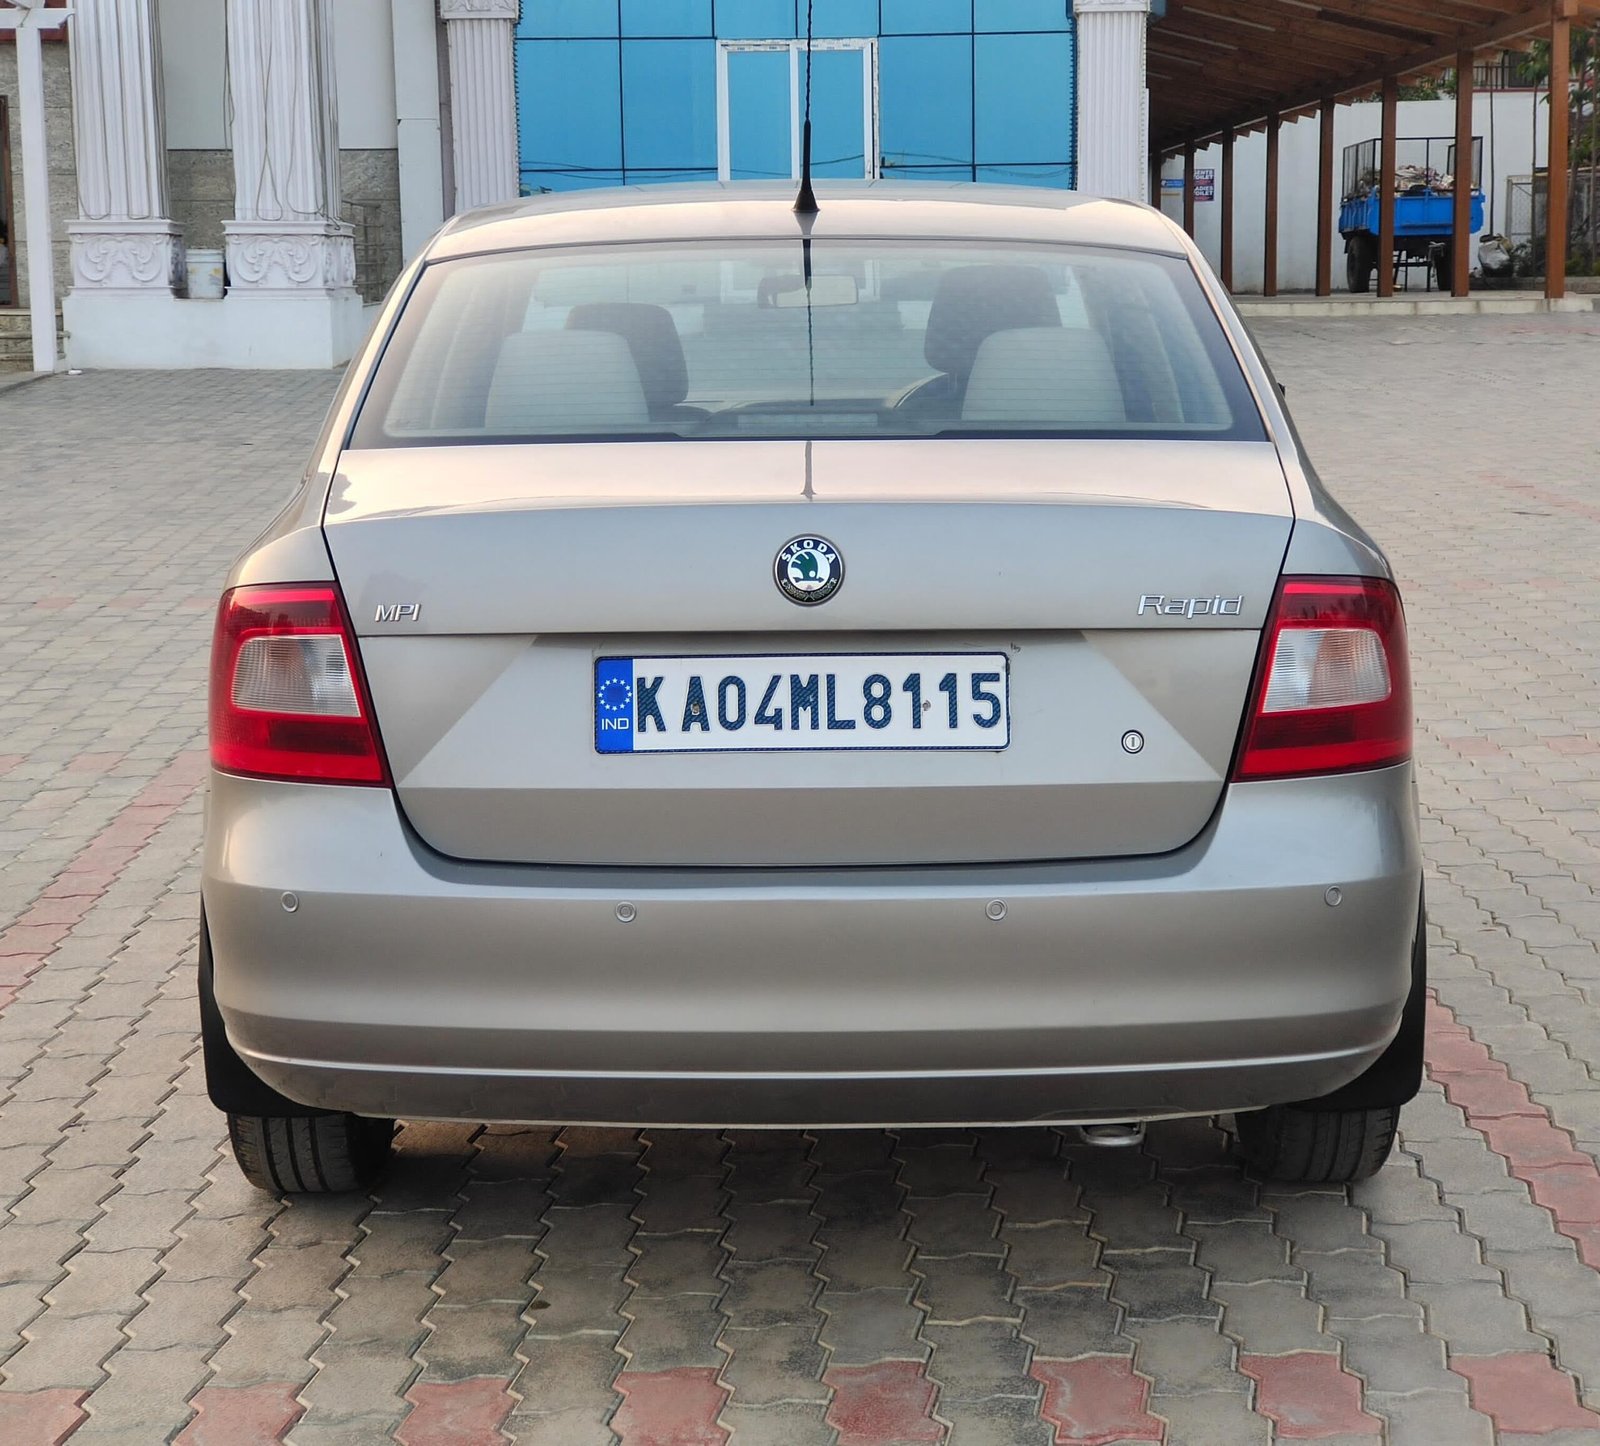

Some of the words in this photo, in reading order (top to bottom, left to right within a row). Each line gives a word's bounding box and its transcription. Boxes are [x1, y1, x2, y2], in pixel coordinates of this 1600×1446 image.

[781, 540, 836, 563] SKODA
[375, 603, 420, 621] MPI
[1137, 595, 1243, 619] Rapid
[637, 672, 1002, 733] KA04ML8115
[601, 718, 629, 730] IND
